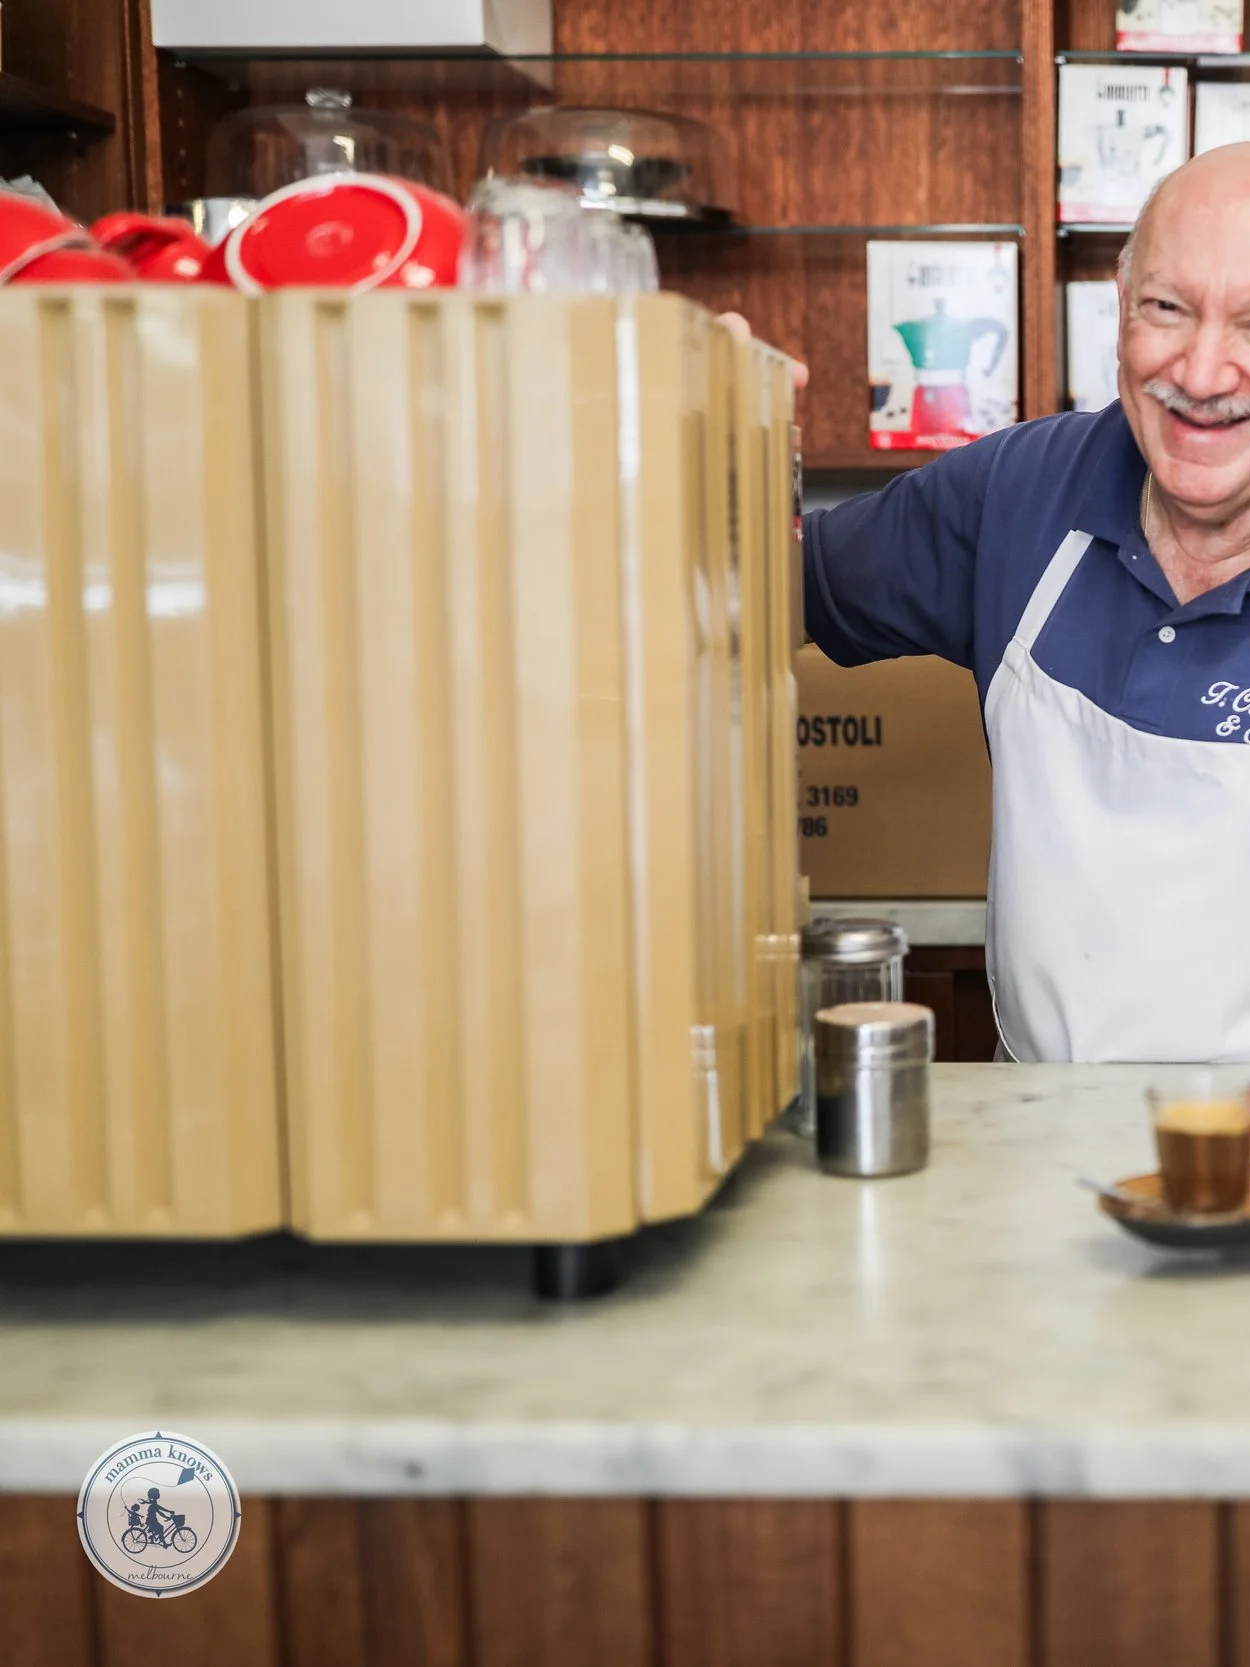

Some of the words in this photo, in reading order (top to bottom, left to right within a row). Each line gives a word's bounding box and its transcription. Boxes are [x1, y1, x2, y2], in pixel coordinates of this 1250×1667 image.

[797, 715, 882, 747] OSTOLI
[1215, 714, 1241, 737] &
[807, 785, 858, 807] 3169
